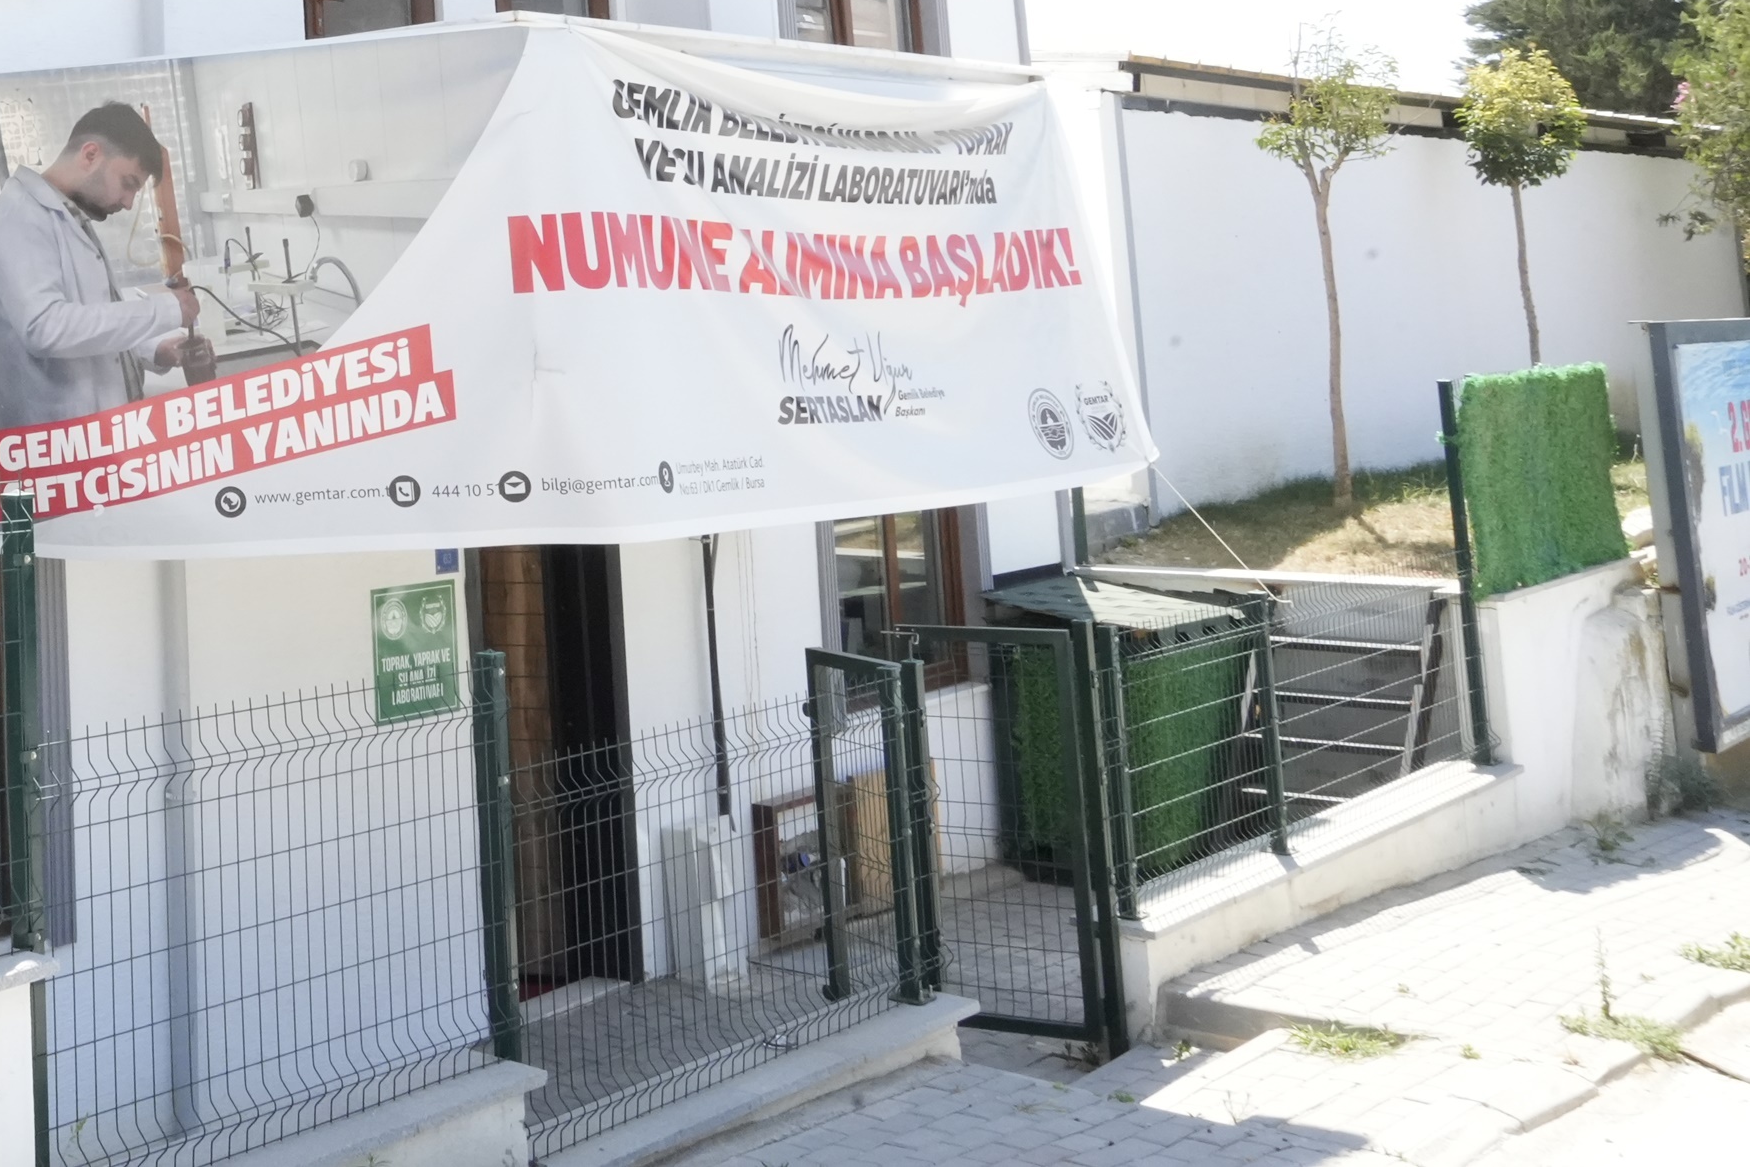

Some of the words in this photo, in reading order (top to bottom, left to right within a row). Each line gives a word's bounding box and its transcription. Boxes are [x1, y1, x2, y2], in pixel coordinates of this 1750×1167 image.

[711, 152, 819, 200] ANALİZİ
[818, 163, 997, 205] LABORATUVARI'nda
[507, 211, 732, 294] NUMUNE
[739, 227, 902, 300] ALIMINA
[900, 227, 1083, 308] BAŞLADIK!
[778, 395, 883, 425] SERTASLAN
[1083, 395, 1109, 405] GEMTAR
[242, 381, 446, 465] YANINDA
[432, 485, 460, 497] 444
[465, 485, 482, 496] 10
[746, 477, 765, 489] Bursa
[413, 649, 440, 667] YAPRAK
[441, 648, 450, 662] VE
